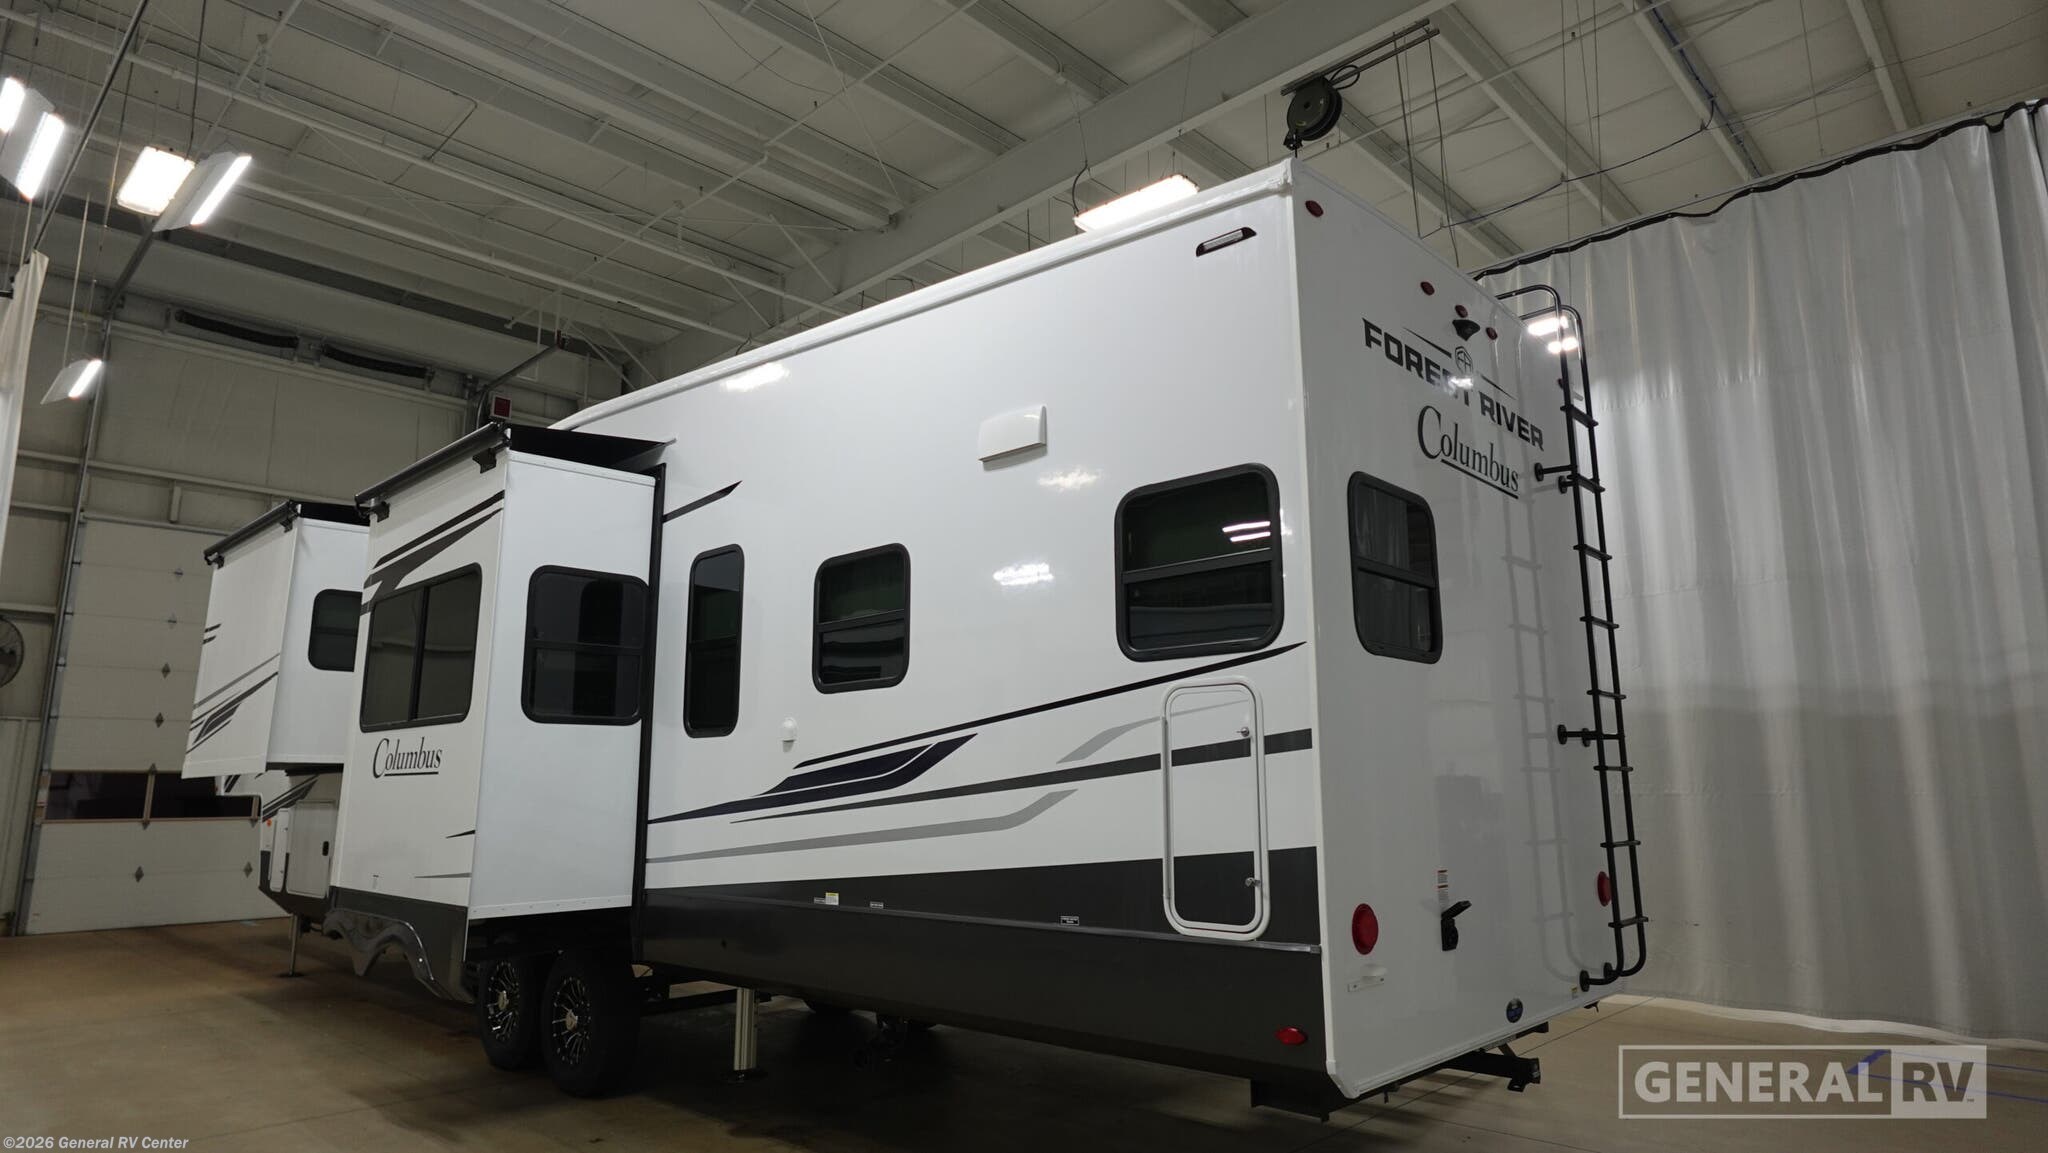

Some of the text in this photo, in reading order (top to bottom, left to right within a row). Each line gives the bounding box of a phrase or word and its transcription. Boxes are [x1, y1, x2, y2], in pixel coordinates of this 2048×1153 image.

[1362, 317, 1545, 451] FORET RIVER
[1417, 405, 1519, 492] Columbus
[372, 736, 443, 779] Columbus
